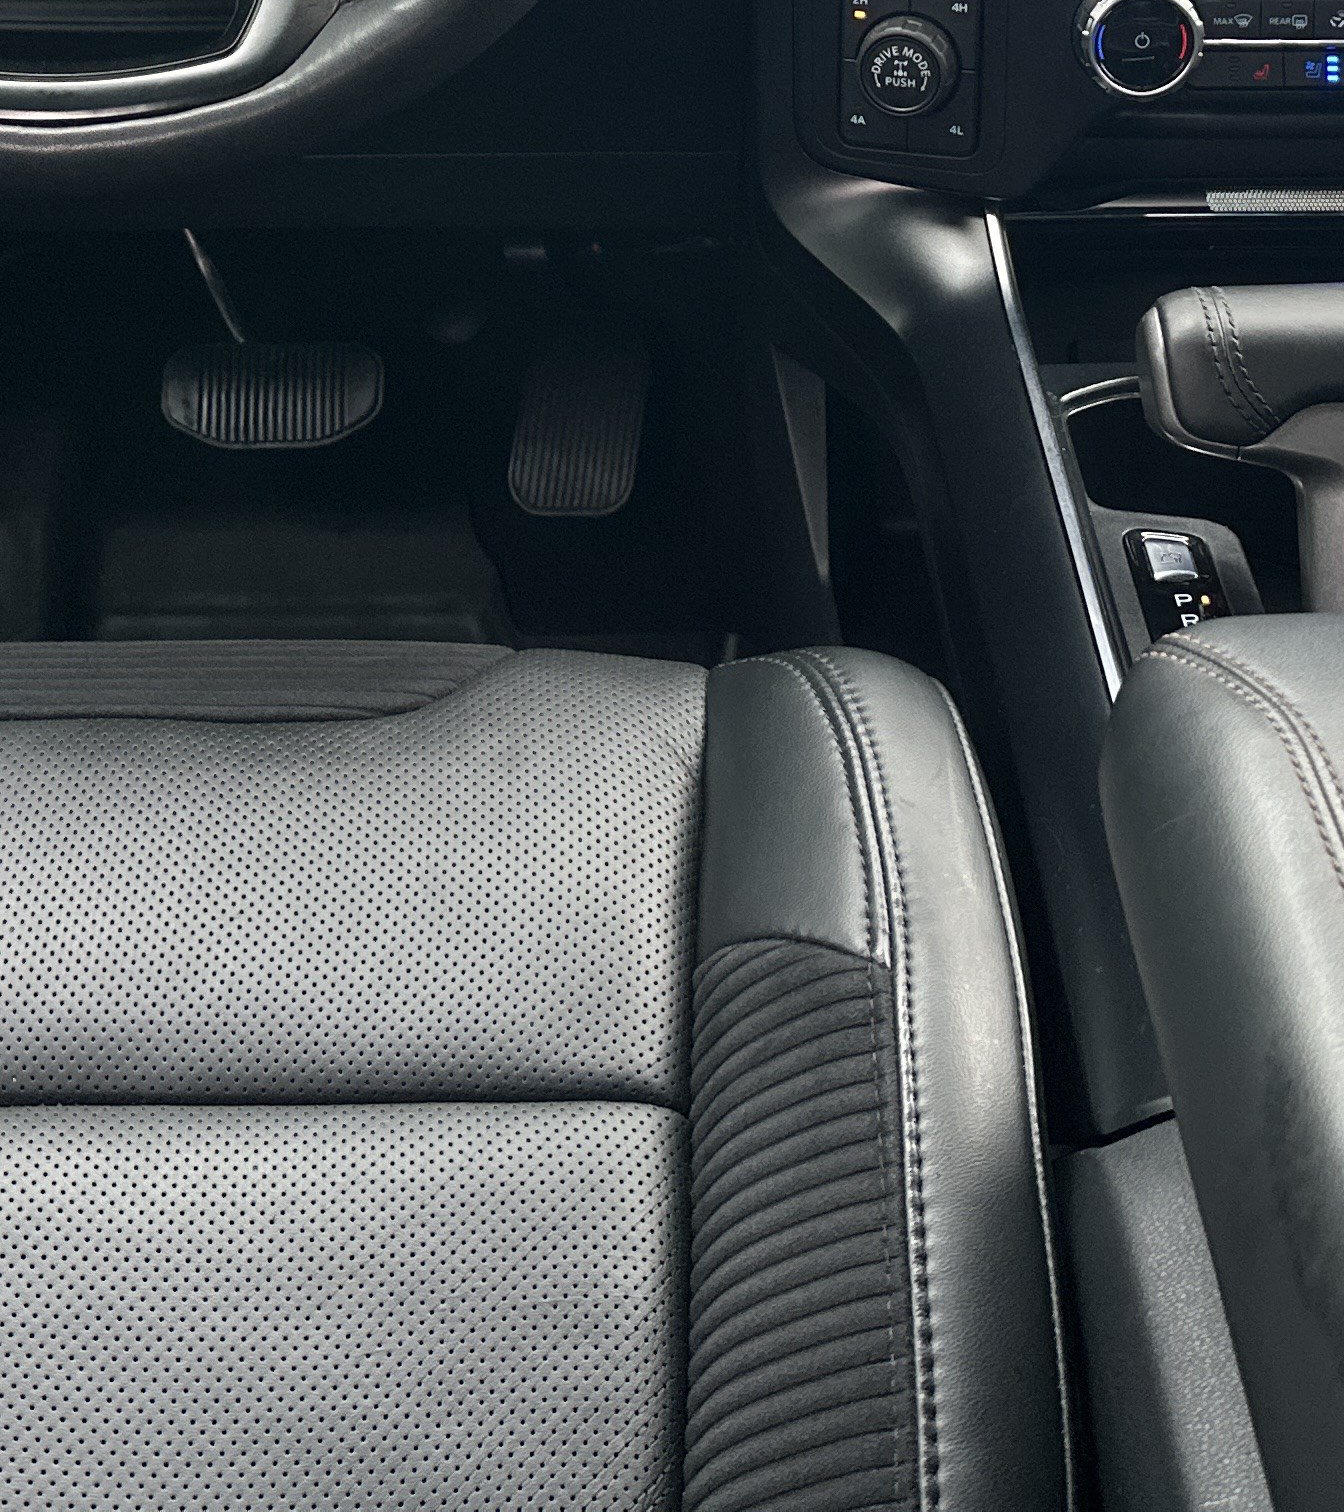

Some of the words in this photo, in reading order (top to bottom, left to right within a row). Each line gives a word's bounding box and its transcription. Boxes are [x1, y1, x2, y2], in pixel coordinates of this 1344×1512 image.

[951, 2, 968, 13] 4H
[1213, 17, 1234, 26] MAX
[1269, 17, 1291, 26] REAR
[871, 45, 900, 76] DRIVE
[903, 46, 931, 78] MODE
[885, 76, 916, 88] PUSH
[850, 114, 866, 125] 4A
[949, 125, 964, 136] 4L
[1174, 593, 1193, 607] P
[1181, 614, 1200, 627] R
